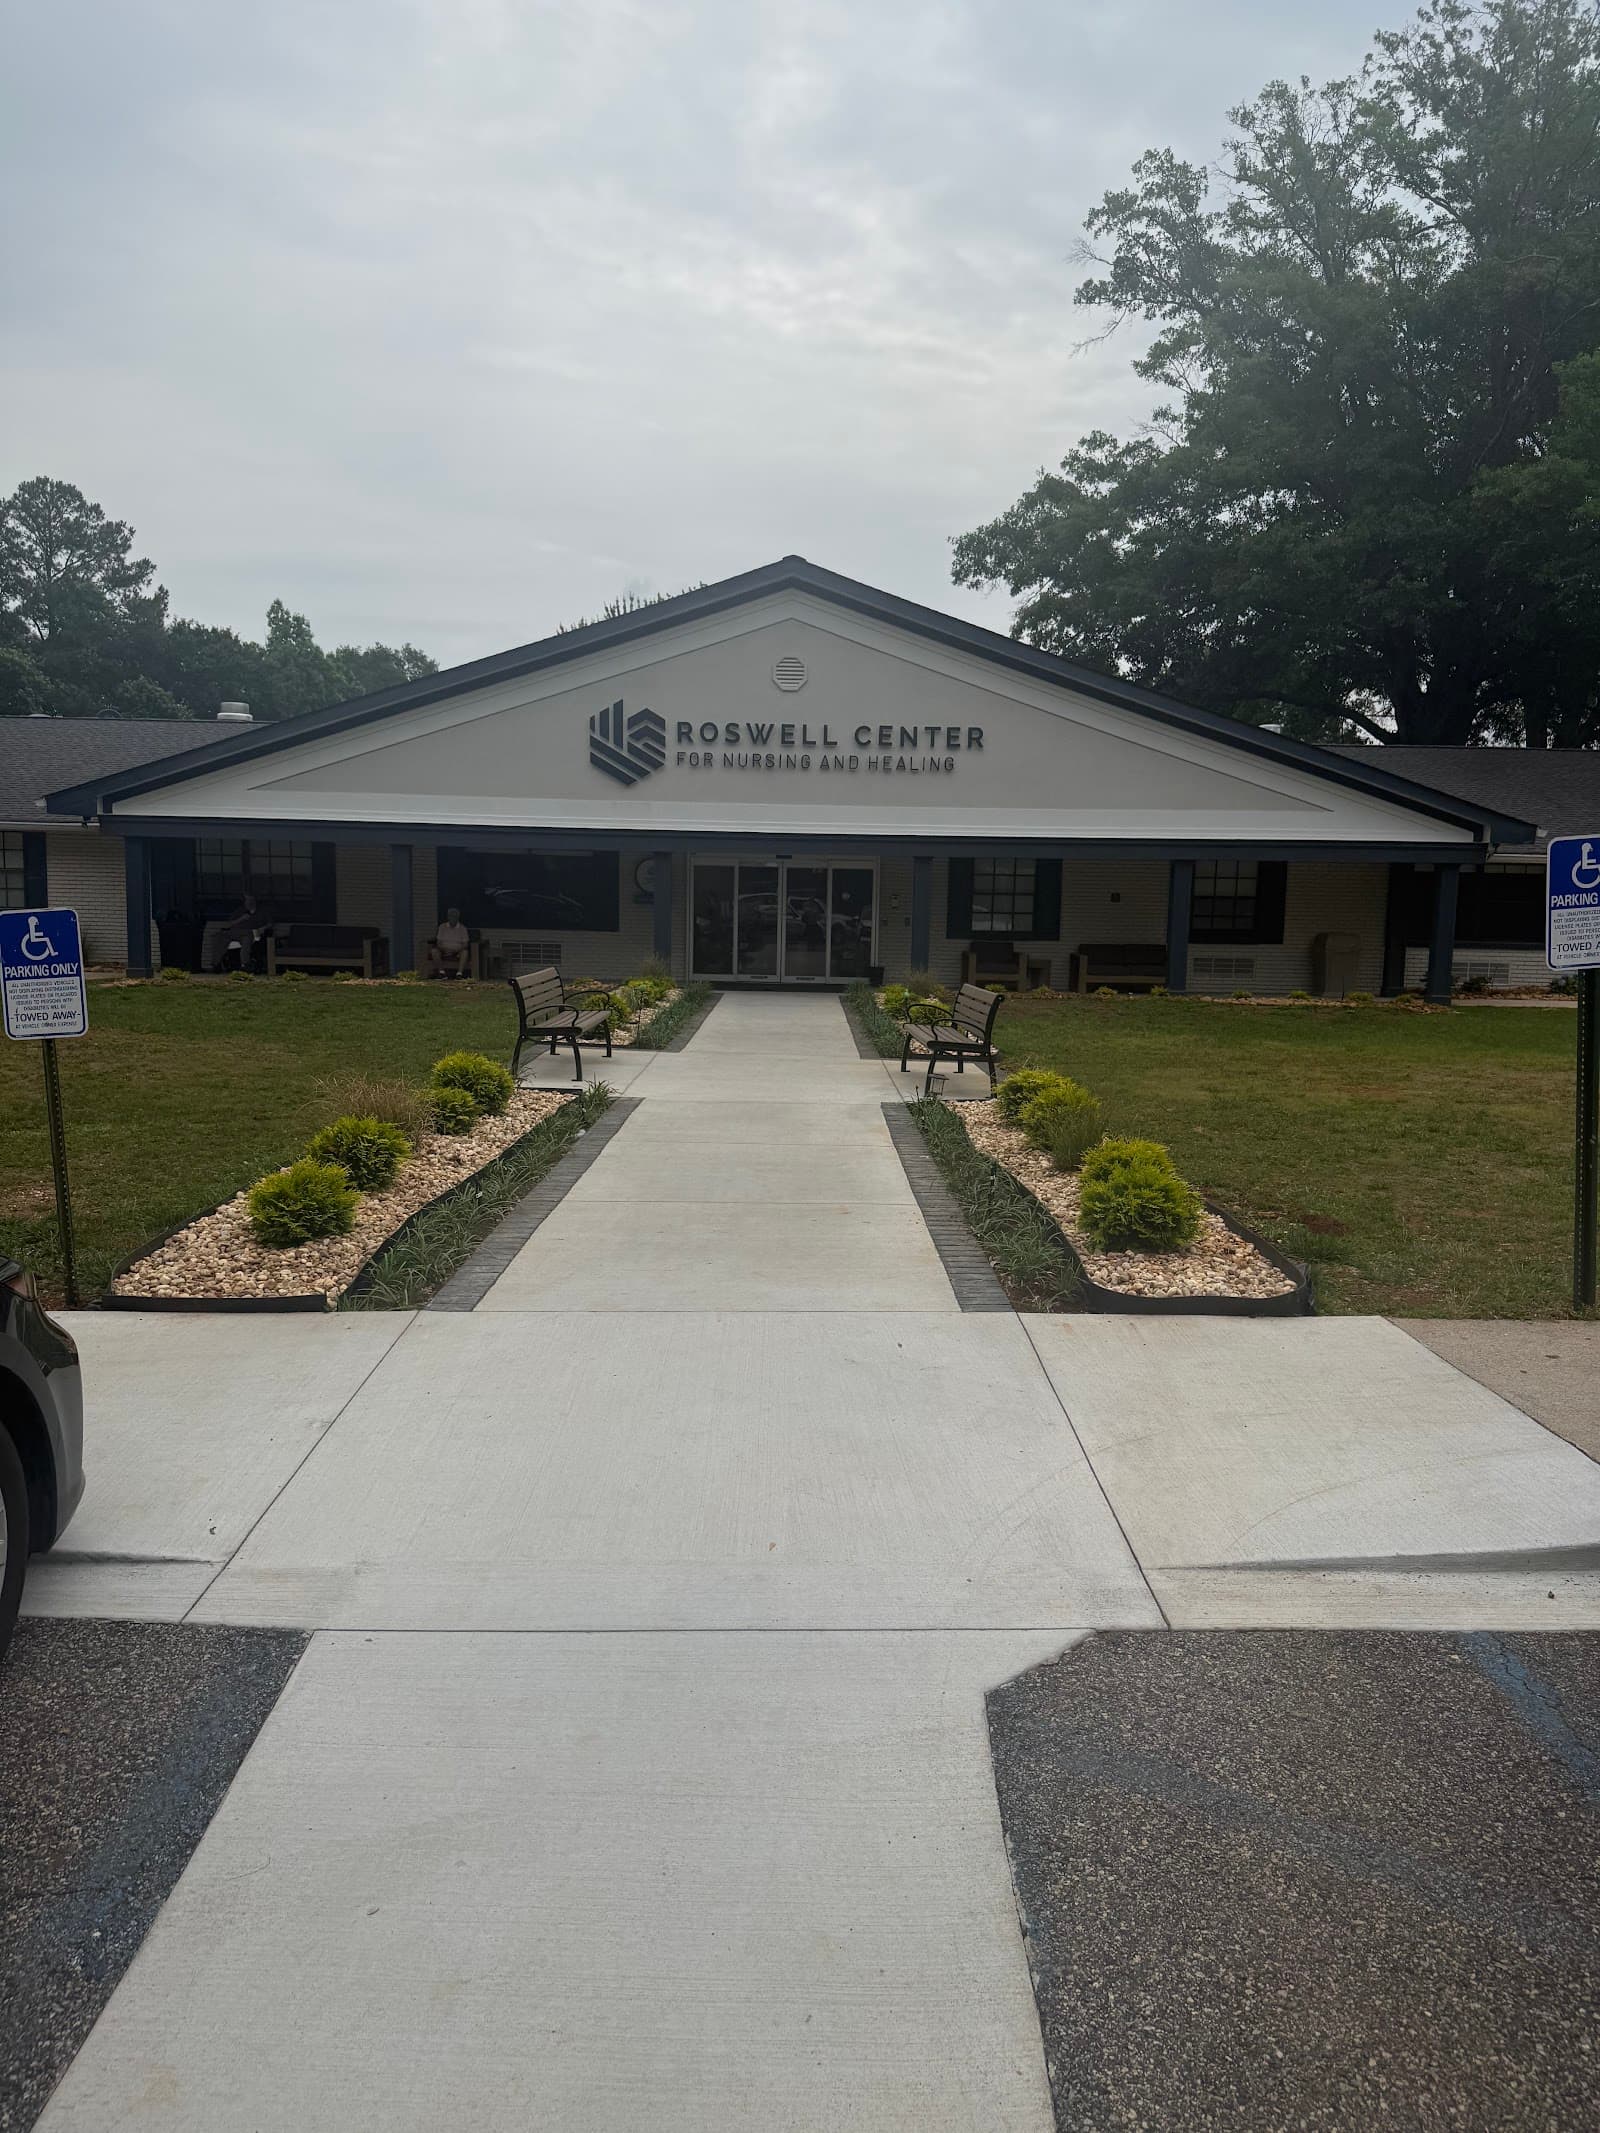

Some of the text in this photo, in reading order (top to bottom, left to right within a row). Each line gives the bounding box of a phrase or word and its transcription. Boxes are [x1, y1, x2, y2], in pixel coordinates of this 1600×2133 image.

[677, 721, 984, 749] ROSWELL CENTER
[677, 752, 955, 771] FOR NURSING AND HEALING
[1551, 892, 1599, 907] PARKING
[4, 962, 78, 978] PARKING ONLY
